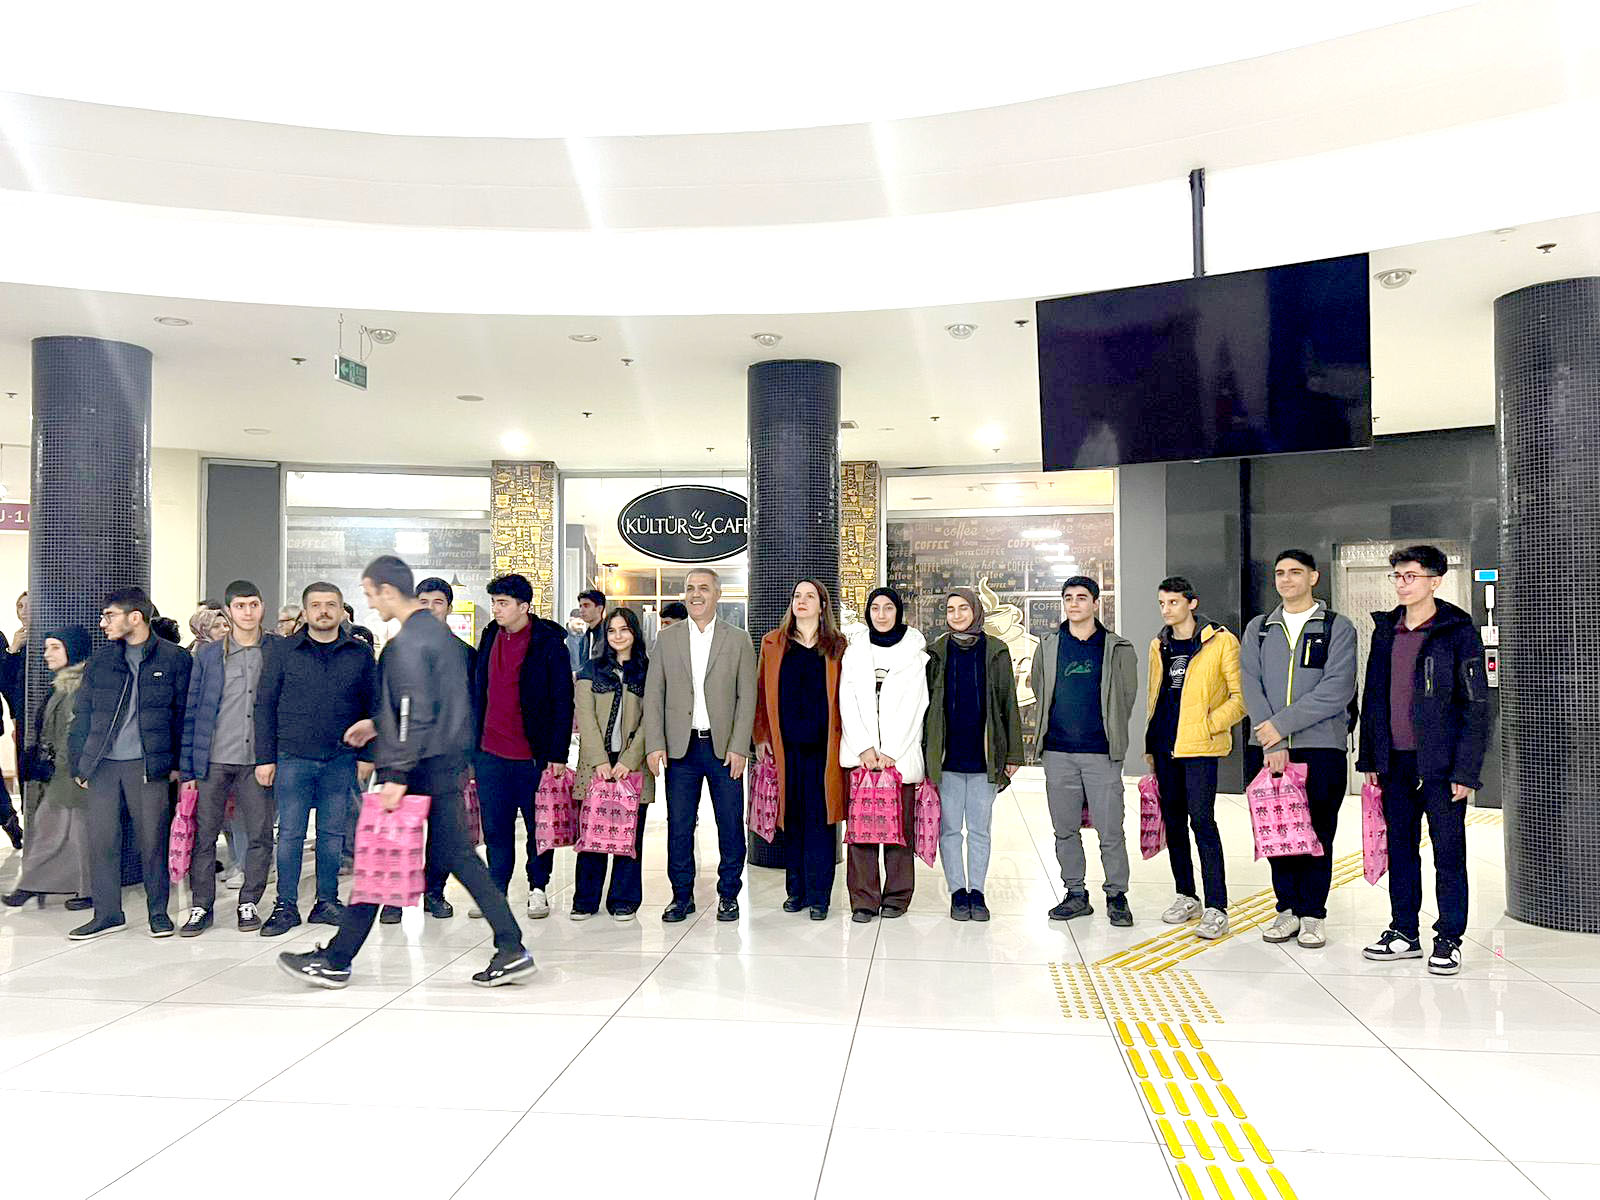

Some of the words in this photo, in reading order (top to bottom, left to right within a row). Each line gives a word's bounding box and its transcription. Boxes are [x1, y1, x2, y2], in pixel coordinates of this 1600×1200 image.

[626, 515, 688, 534] KÜLTÜR
[943, 521, 978, 540] coffee
[914, 540, 950, 550] COFFEE
[888, 550, 913, 558] OFFEE
[914, 561, 941, 573] COFFEE
[1007, 560, 1034, 572] COFFEE
[888, 571, 912, 580] offee
